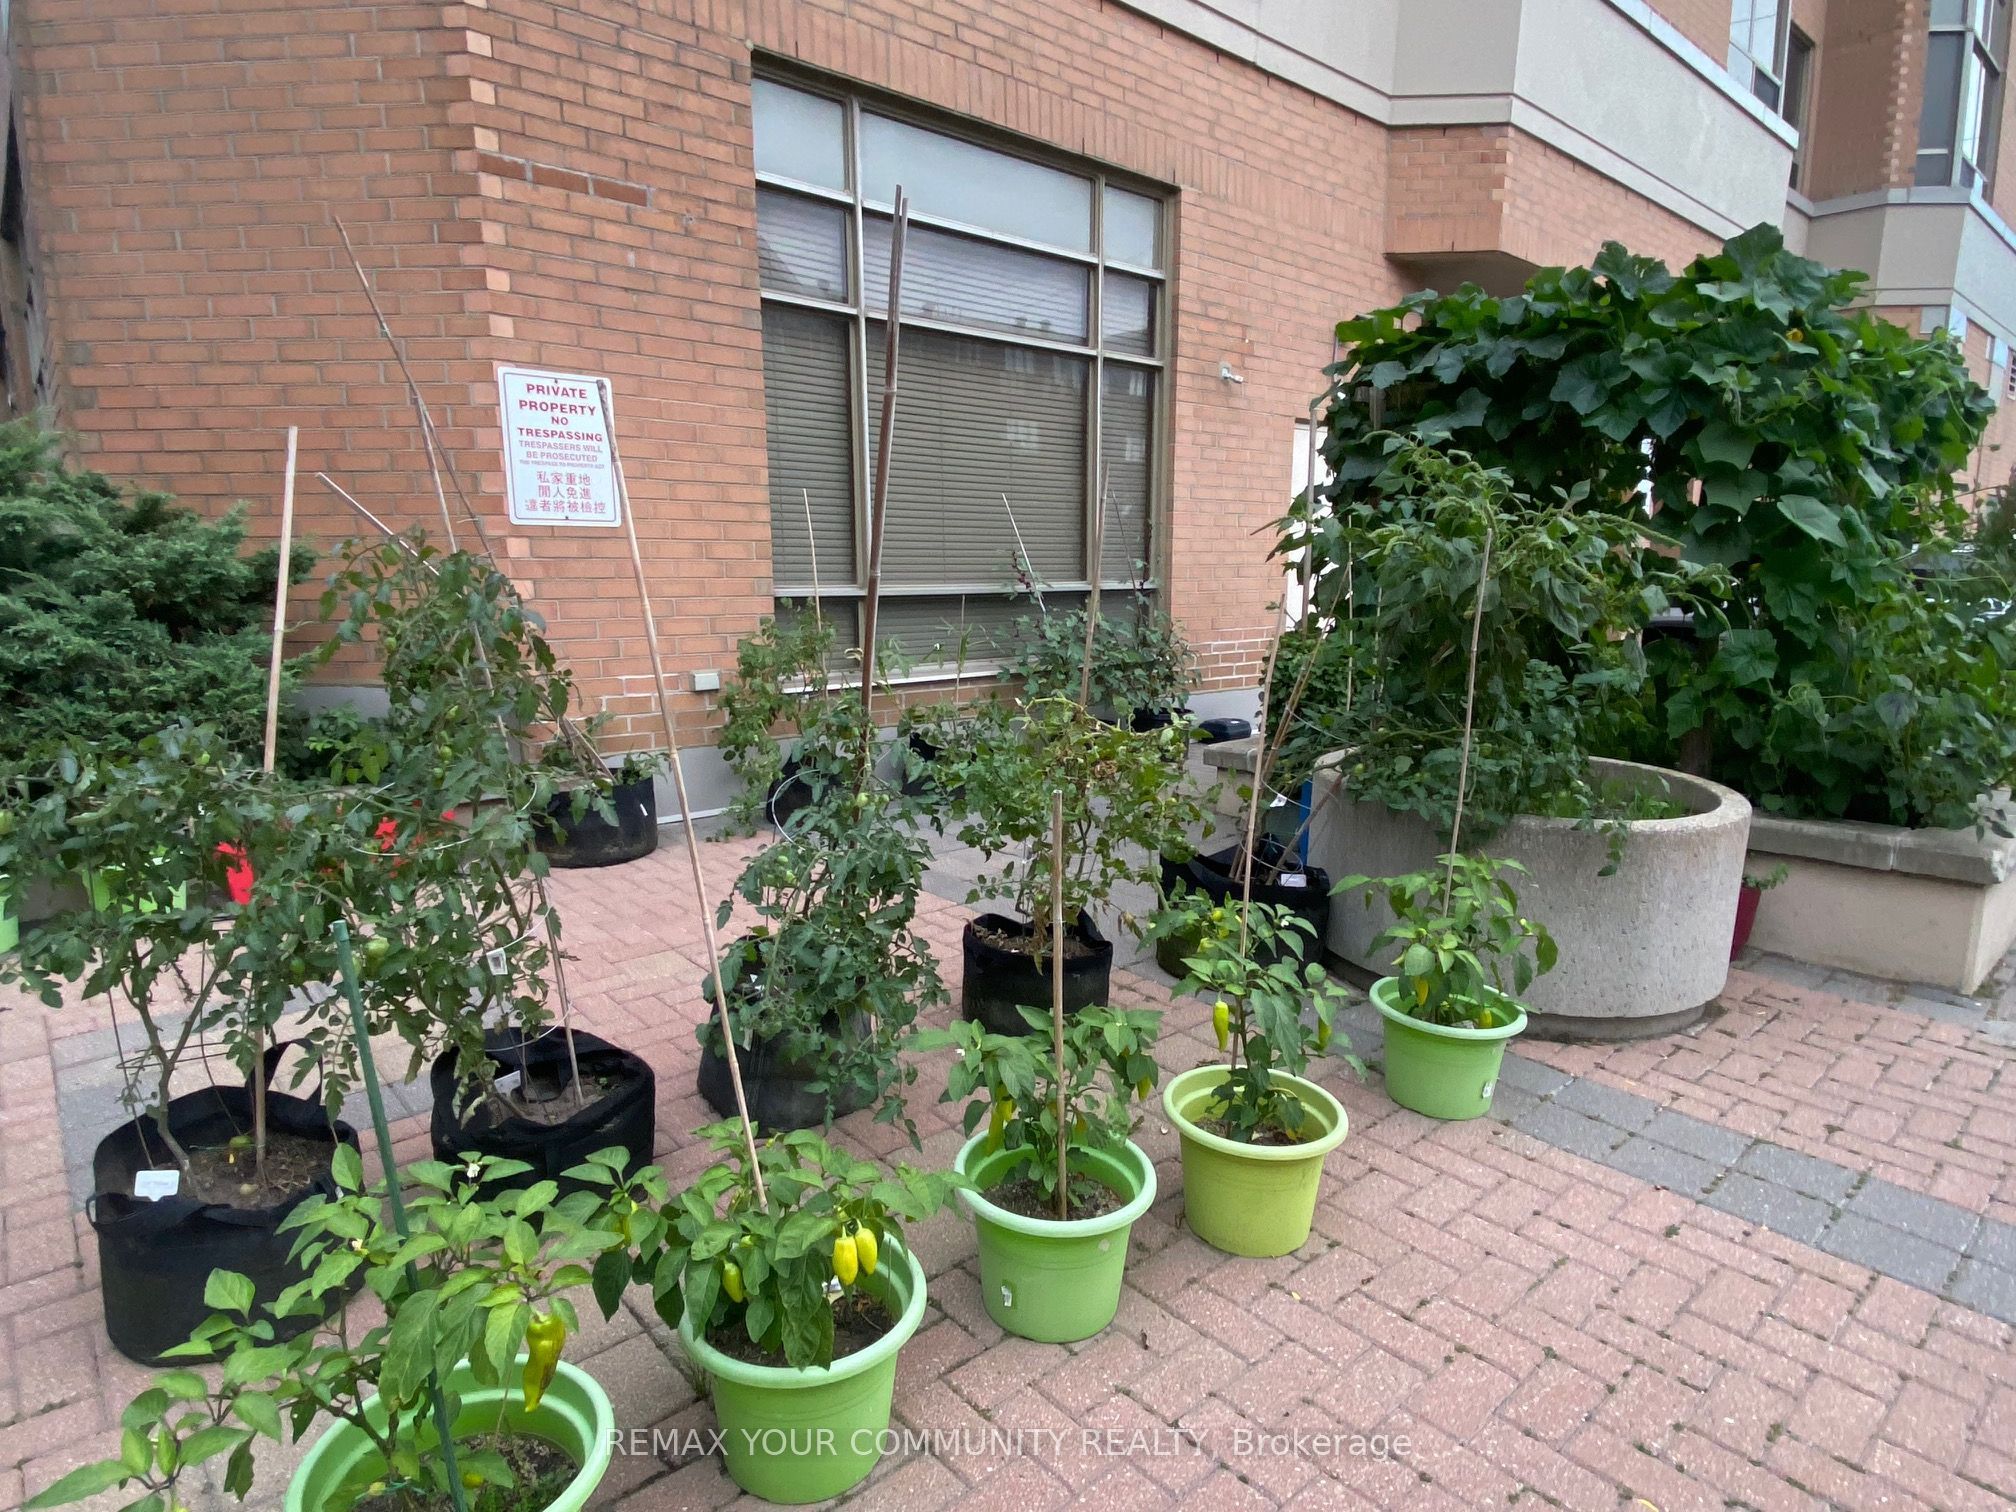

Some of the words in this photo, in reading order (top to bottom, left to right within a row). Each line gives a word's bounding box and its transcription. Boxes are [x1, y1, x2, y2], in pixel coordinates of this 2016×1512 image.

[526, 383, 588, 399] PRIVATE
[518, 399, 596, 416] PROPERTY
[551, 416, 569, 426] NO
[517, 427, 603, 442] TRESPASSING
[519, 440, 582, 452] TRESPASSERS
[583, 444, 604, 453] WILL
[526, 451, 539, 459] BE
[540, 451, 598, 463] PROSECUTED
[536, 470, 592, 486] 私家重地
